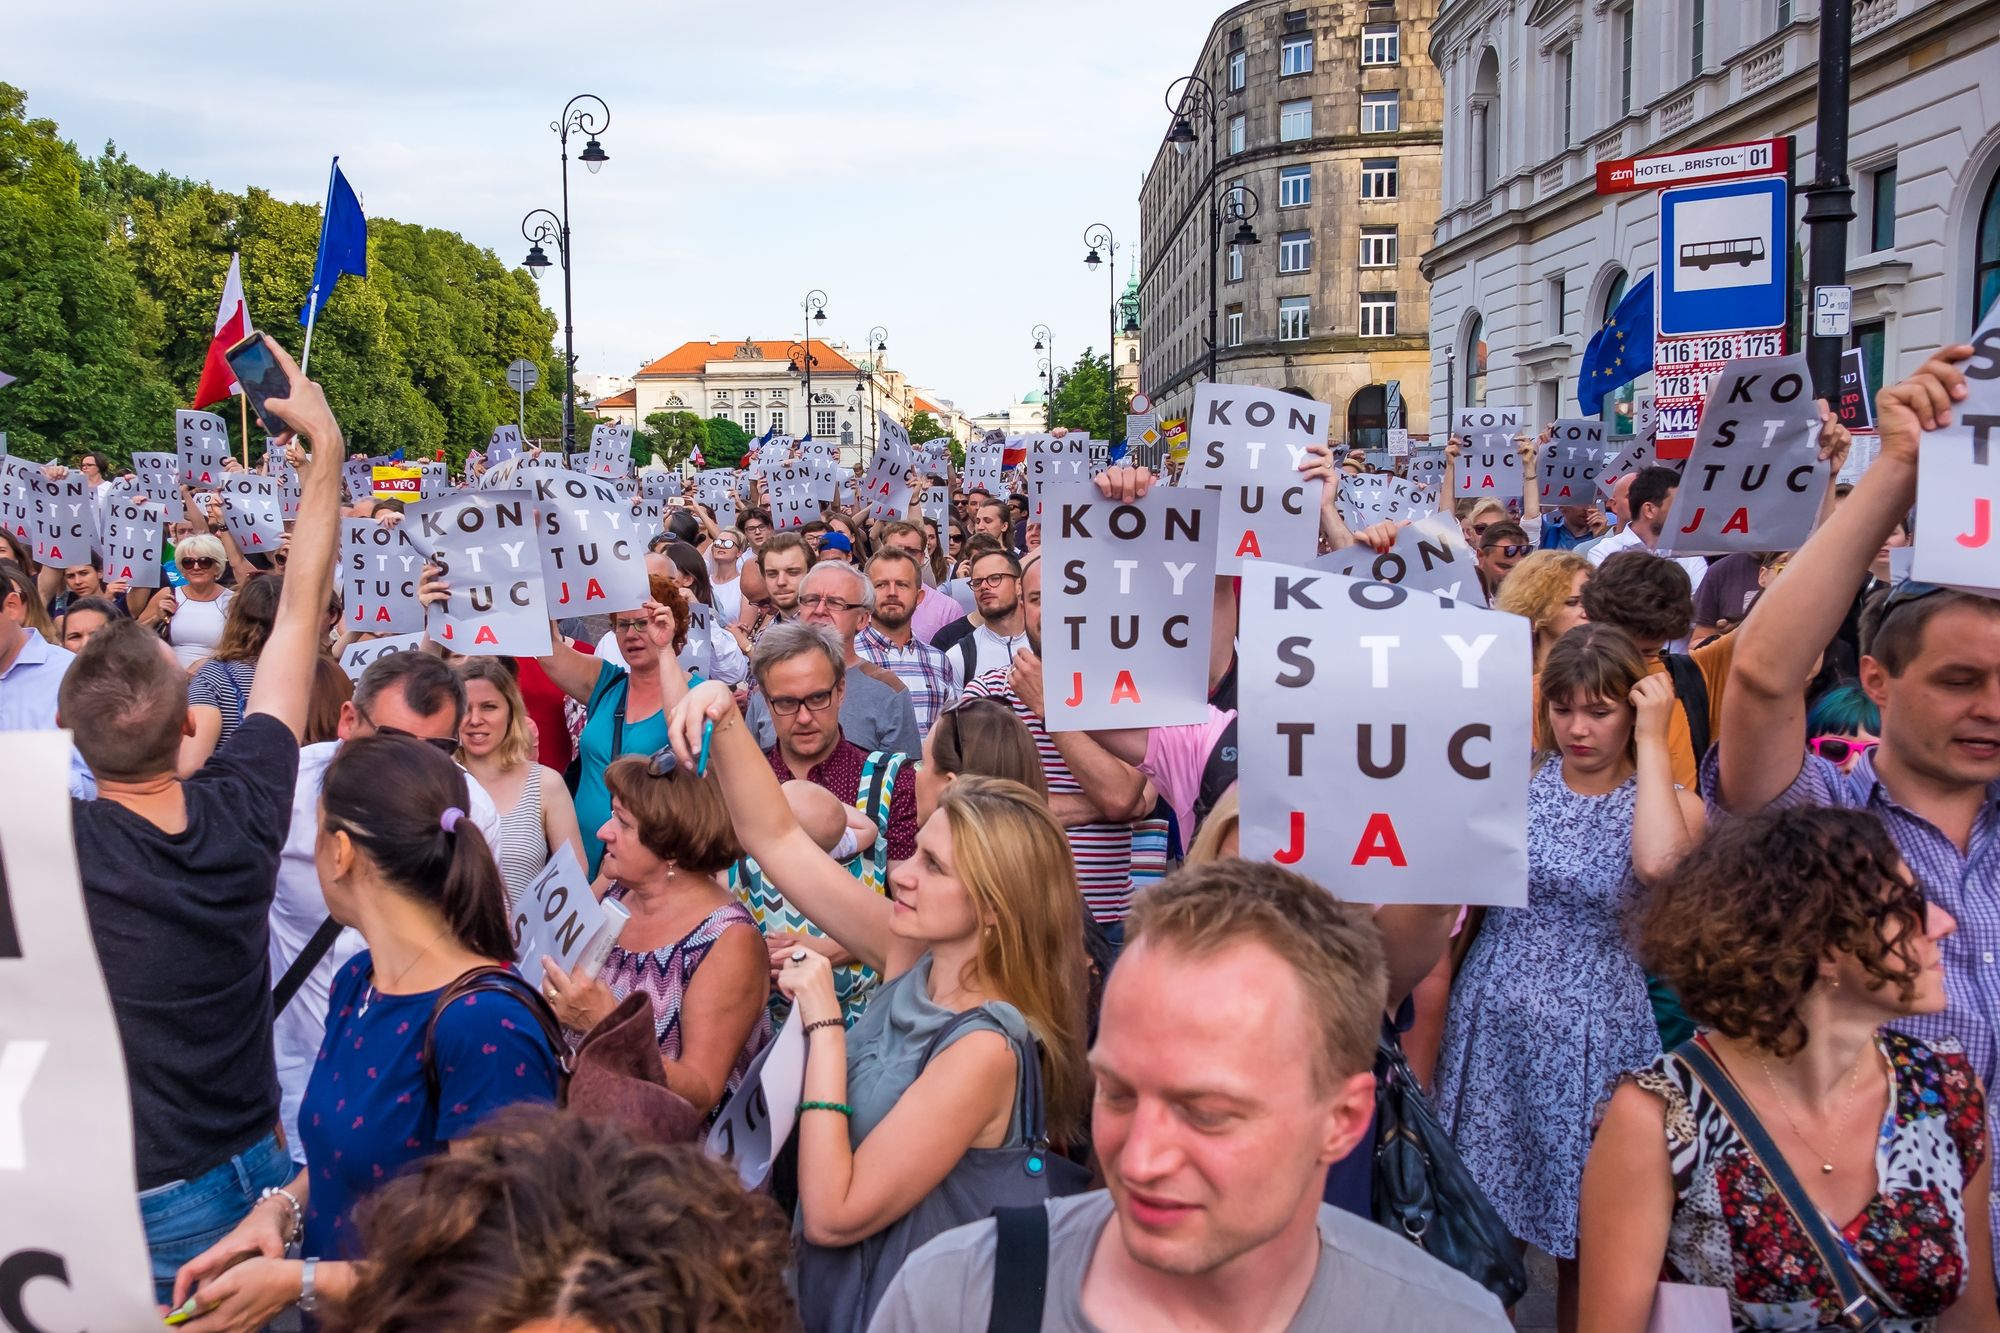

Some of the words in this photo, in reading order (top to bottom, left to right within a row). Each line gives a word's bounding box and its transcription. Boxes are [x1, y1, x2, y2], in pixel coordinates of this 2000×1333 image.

[1610, 168, 1632, 181] ztm
[1635, 164, 1675, 177] HOTEL
[1750, 147, 1767, 165] 01
[1819, 294, 1828, 307] D
[1662, 343, 1690, 363] 116
[1701, 340, 1732, 360] 128
[1744, 336, 1775, 357] 175
[1660, 377, 1690, 396] 178
[1841, 373, 1857, 384] UJ
[1728, 373, 1803, 403] KO
[184, 418, 225, 433] KON
[1208, 400, 1316, 435] KON
[1462, 414, 1516, 427] KON
[1660, 410, 1694, 431] N44
[597, 427, 629, 438] KON
[882, 418, 909, 445] KON
[1551, 426, 1602, 441] KON
[1712, 419, 1821, 449] STY
[185, 436, 226, 450] STY
[596, 437, 627, 450] STY
[971, 445, 1000, 453] KON
[1033, 440, 1083, 454] KON
[1463, 434, 1515, 448] STY
[595, 450, 624, 463] TUC
[804, 446, 834, 455] KON
[884, 438, 910, 463] STY
[1205, 441, 1306, 471] STY
[1547, 446, 1598, 461] STY
[139, 459, 177, 469] KON
[185, 453, 228, 467] TUC
[592, 463, 610, 473] JA
[970, 457, 998, 466] STY
[1035, 460, 1082, 474] STY
[1413, 461, 1446, 470] KON
[1464, 454, 1514, 467] TUC
[6, 463, 41, 480] KO
[186, 470, 212, 483] JA
[773, 467, 810, 481] KON
[878, 458, 912, 482] TUC
[969, 469, 996, 478] TUC
[1546, 465, 1594, 479] TUC
[1702, 464, 1814, 492] TUC
[30, 478, 82, 496] KON
[221, 480, 271, 495] KON
[392, 480, 416, 490] VETO
[646, 475, 676, 483] KON
[698, 477, 731, 487] KON
[868, 477, 889, 496] JA
[1463, 475, 1494, 489] JA
[146, 489, 178, 499] TUC
[536, 478, 616, 503] KON
[648, 486, 676, 495] STY
[775, 483, 810, 497] STY
[1395, 484, 1437, 503] KON
[1542, 484, 1571, 497] JA
[36, 499, 82, 517] STY
[224, 498, 271, 510] STY
[778, 499, 813, 512] TUC
[1204, 485, 1304, 515] UC
[111, 505, 157, 522] KON
[875, 506, 895, 516] JA
[1389, 501, 1433, 519] STY
[231, 513, 274, 528] TUC
[421, 501, 523, 537] KON
[546, 511, 621, 535] STY
[781, 516, 802, 528] JA
[1062, 504, 1202, 542] KON
[1680, 507, 1749, 534] JA
[37, 520, 82, 538] TUC
[110, 524, 155, 542] STY
[241, 533, 262, 546] JA
[39, 542, 62, 559] JA
[109, 544, 153, 561] TUC
[432, 541, 525, 576] STY
[551, 540, 630, 569] TUC
[1343, 533, 1455, 584] ON
[108, 564, 132, 578] JA
[353, 553, 415, 573] STY
[1063, 560, 1197, 595] STY
[354, 579, 414, 598] TUC
[559, 578, 606, 604] JA
[1274, 577, 1490, 610] KO
[355, 604, 391, 622] JA
[442, 624, 498, 645] JA
[1064, 615, 1189, 650] TUC
[1275, 634, 1498, 688] STY
[1065, 670, 1141, 707] JA
[1276, 723, 1492, 780] TUC
[1273, 811, 1408, 867] JA
[535, 863, 585, 957] KON
